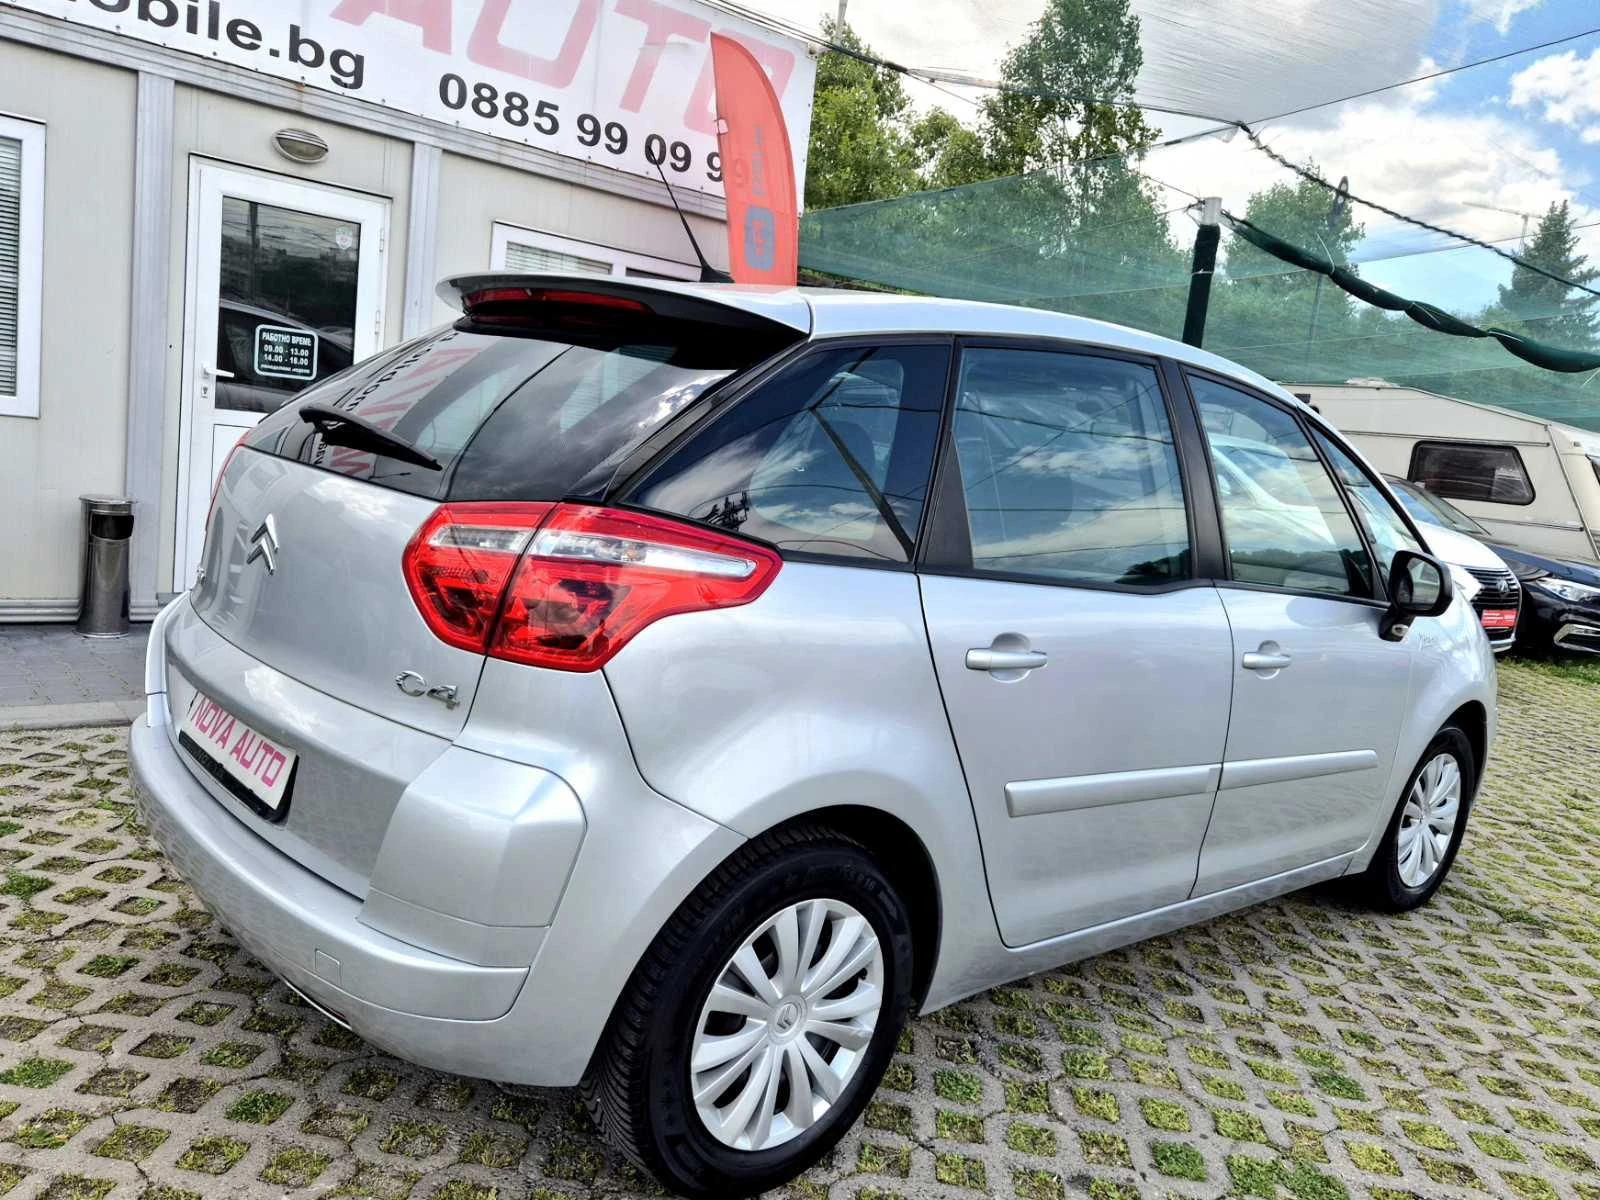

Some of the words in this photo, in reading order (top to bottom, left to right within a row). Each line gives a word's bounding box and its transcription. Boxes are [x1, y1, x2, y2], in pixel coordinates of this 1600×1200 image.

[70, 0, 365, 90] bile.bg
[438, 72, 561, 136] 0885
[576, 113, 629, 155] 99
[644, 133, 692, 173] 09
[396, 670, 460, 711] C4
[191, 696, 237, 749] NOVA
[229, 728, 288, 788] AUTO
